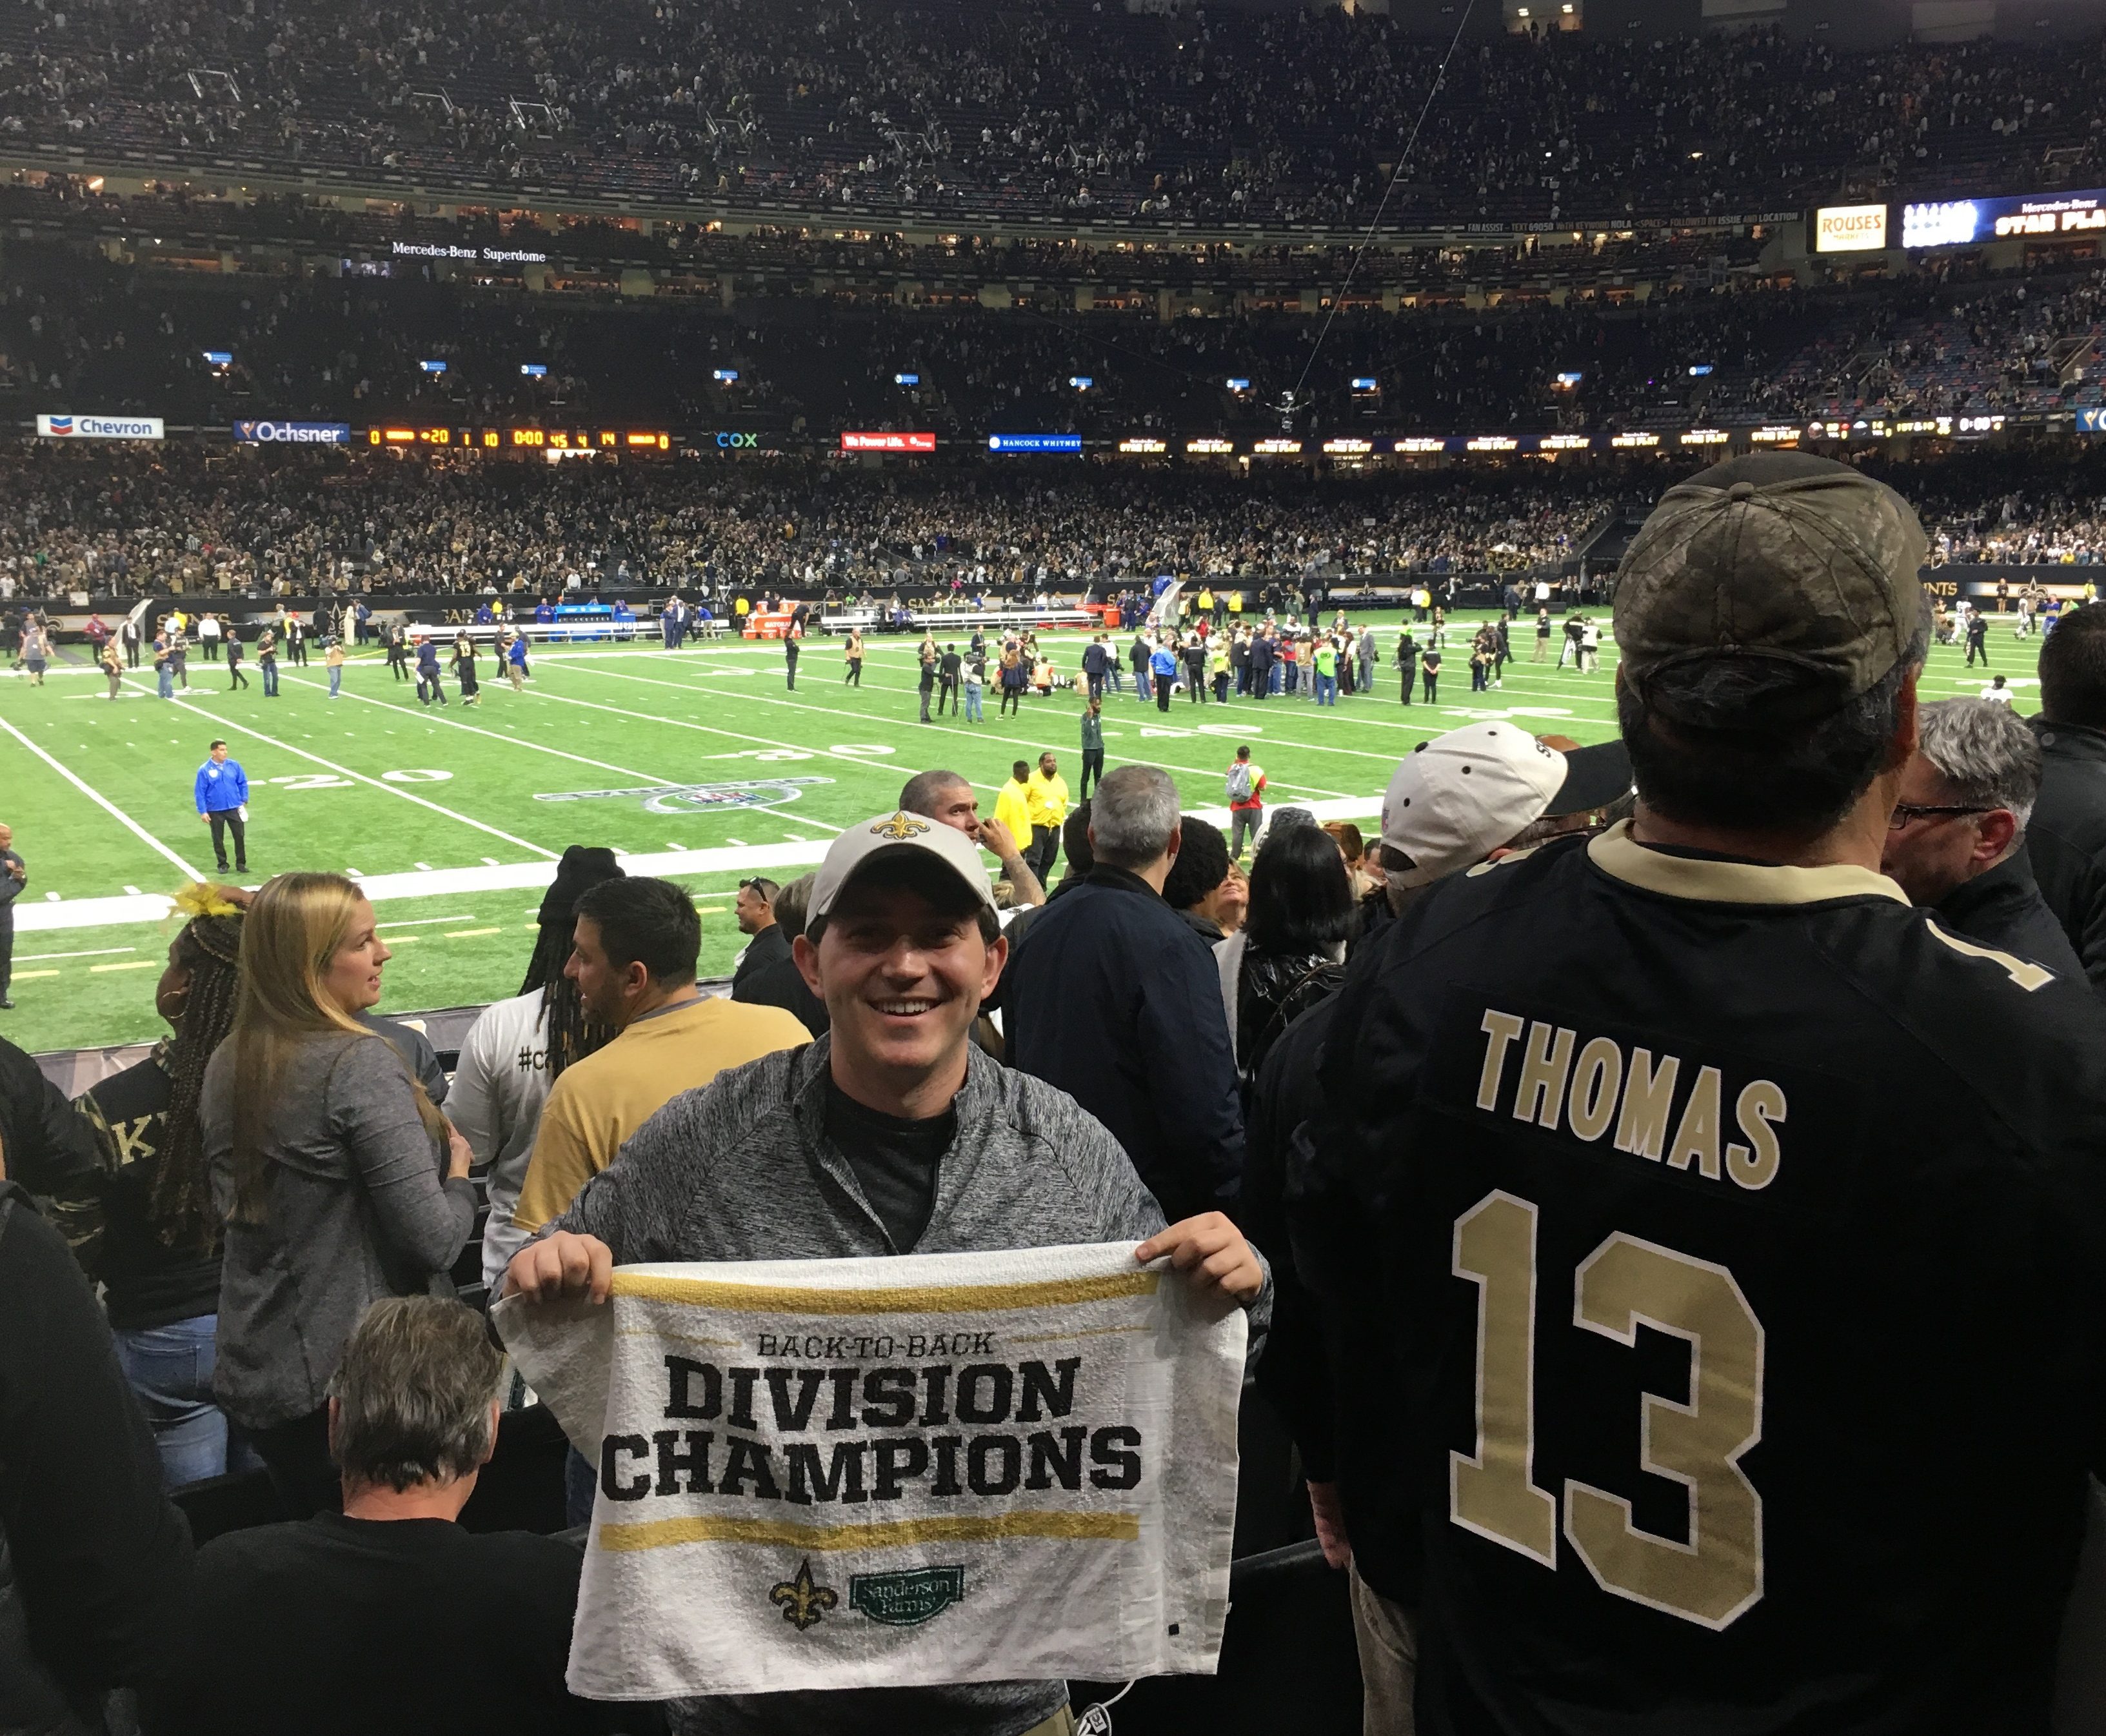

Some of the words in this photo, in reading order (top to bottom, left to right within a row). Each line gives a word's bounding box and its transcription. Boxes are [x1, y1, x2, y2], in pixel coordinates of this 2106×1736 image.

[1468, 223, 1480, 232] FAN
[1482, 223, 1504, 232] ASSIST
[1611, 220, 1632, 229] NOLA
[1718, 215, 1742, 224] ISSUE
[1759, 212, 1798, 223] LOCATION
[1823, 214, 1881, 233] ROUSES
[2061, 209, 2106, 231] PLA
[392, 242, 477, 259] Mercedes-Benz
[483, 248, 546, 262] Superdome
[80, 419, 152, 434] Chevron
[256, 422, 340, 442] Ochsner
[431, 430, 448, 443] 20
[485, 433, 498, 446] 10
[550, 434, 568, 448] 45
[578, 435, 587, 448] 4
[601, 433, 615, 445] 14
[1476, 1008, 1787, 1191] THOMAS
[757, 1331, 996, 1359] BACK-TO-BACK
[664, 1355, 1081, 1432] DIVISION
[1450, 1188, 1765, 1632] 13
[600, 1424, 1142, 1505] CHAMPIONS
[863, 1580, 950, 1599] Sanderson
